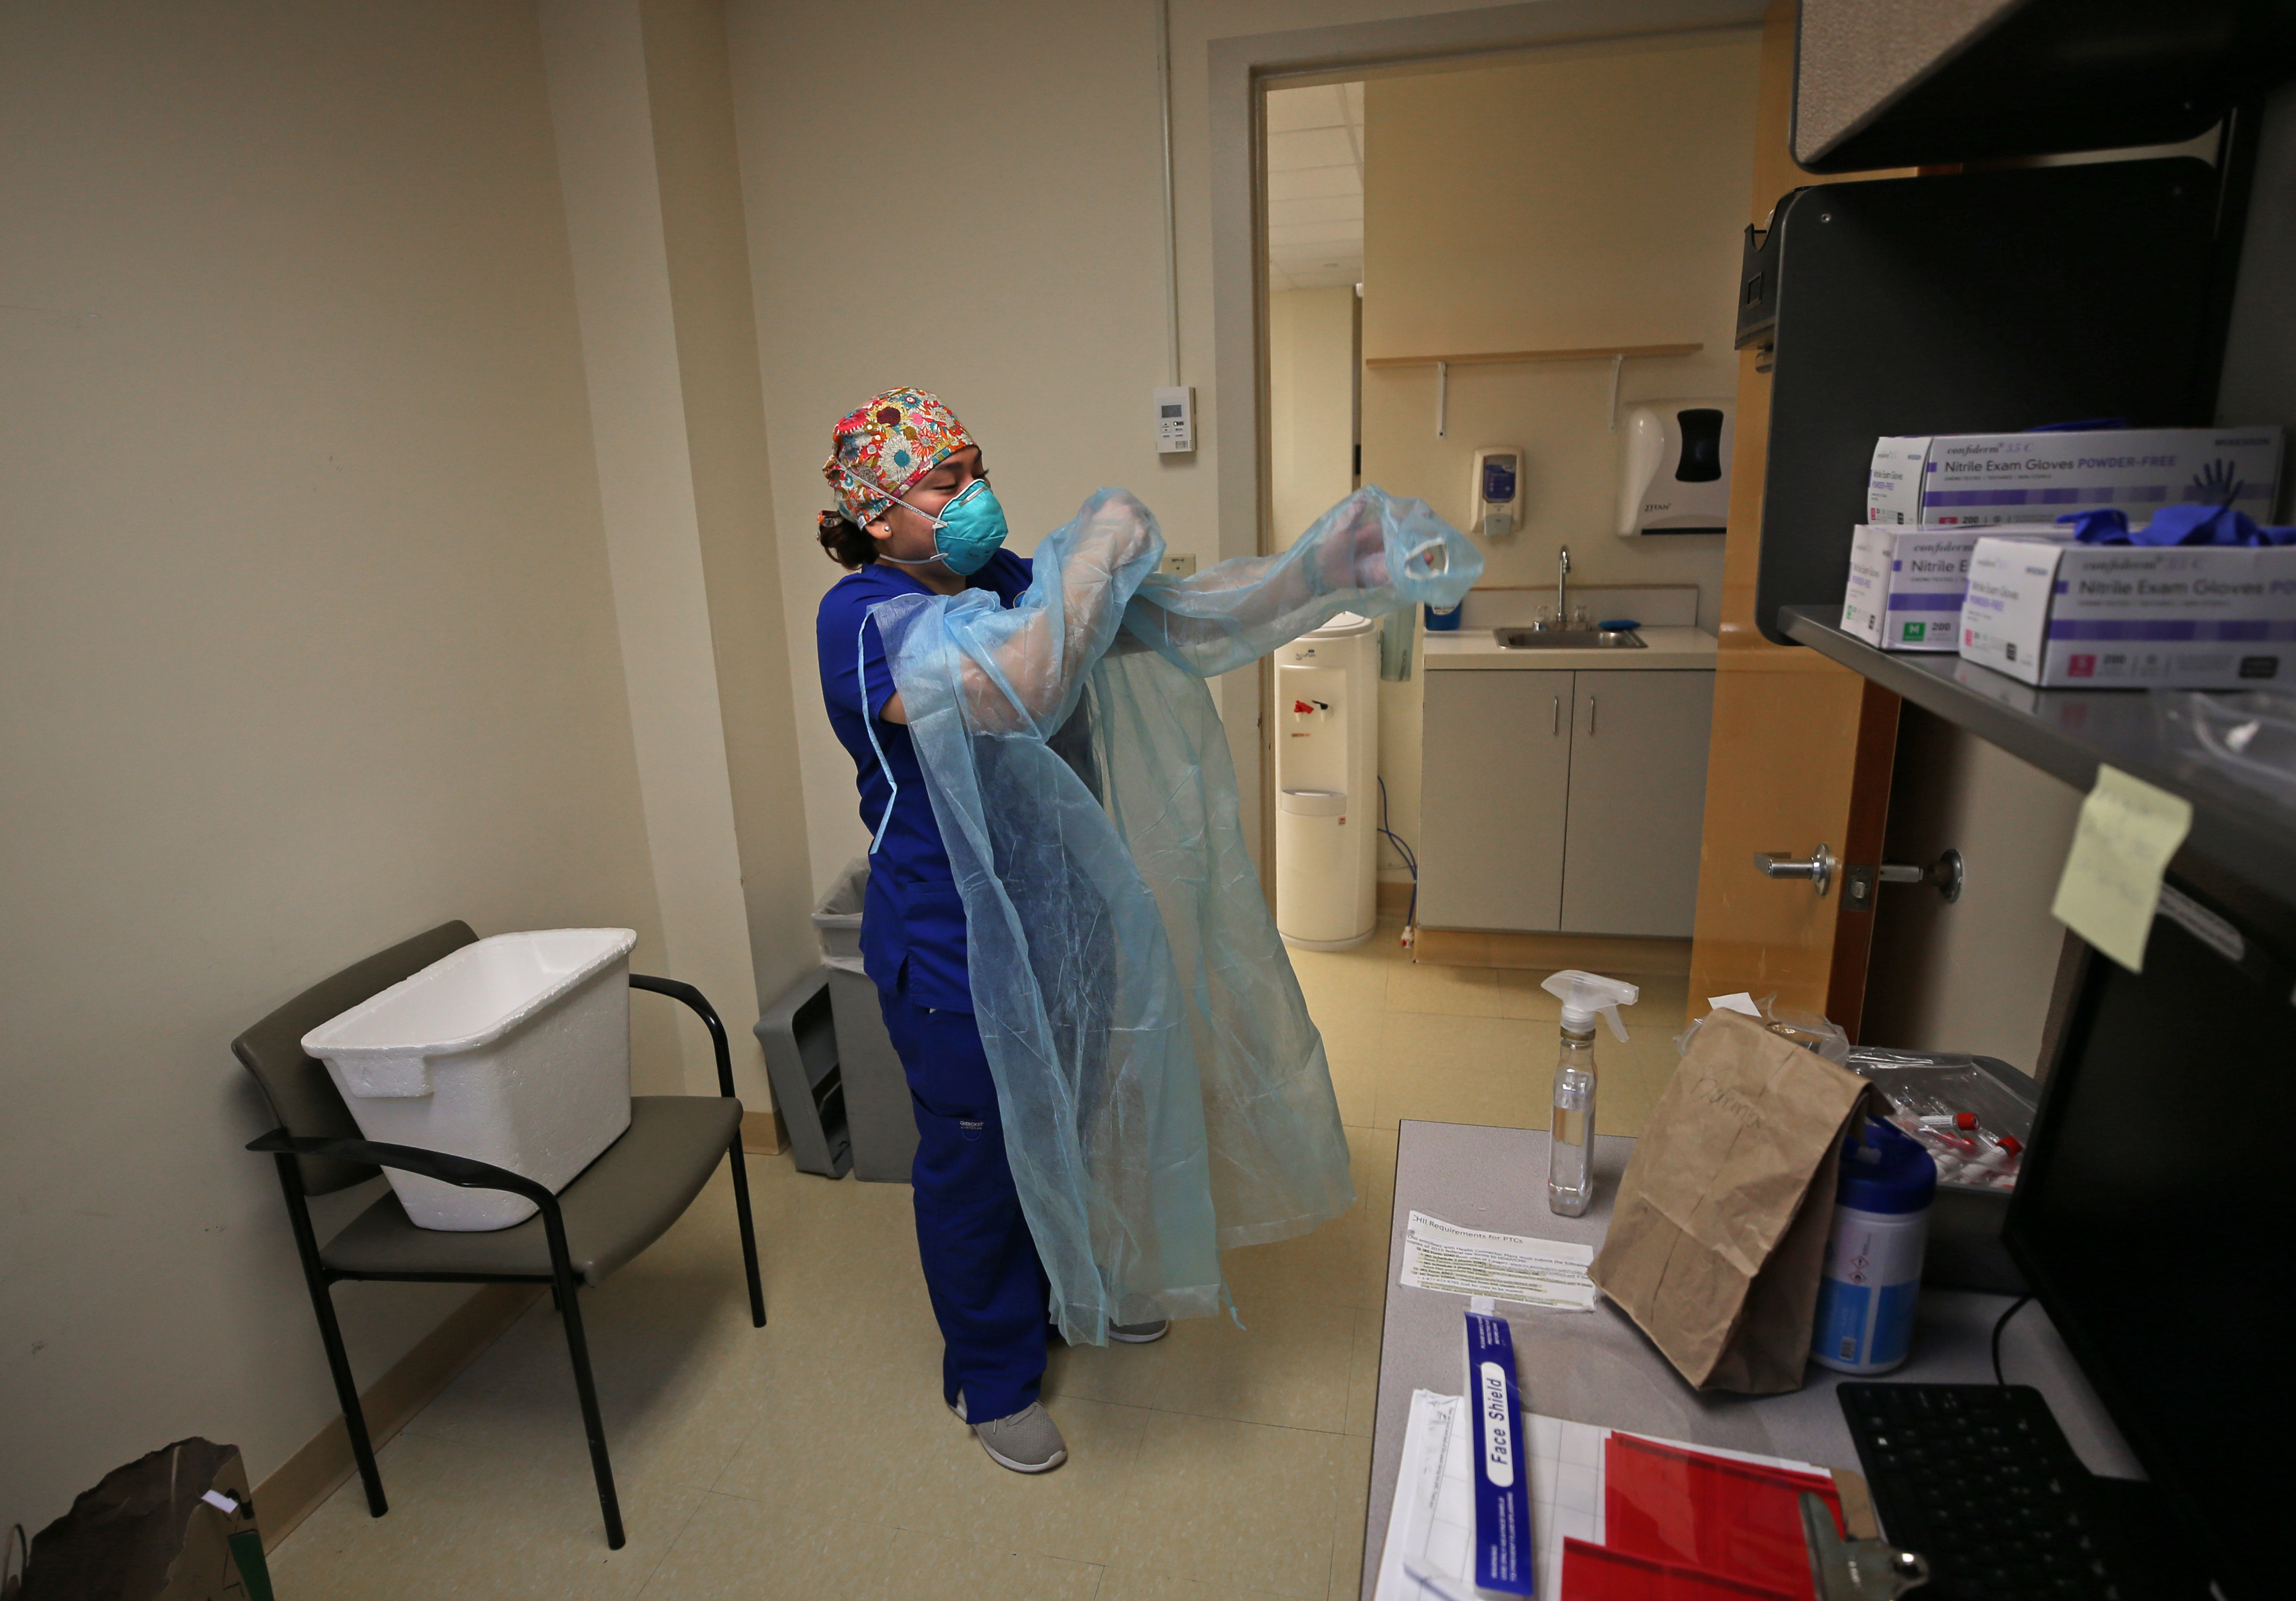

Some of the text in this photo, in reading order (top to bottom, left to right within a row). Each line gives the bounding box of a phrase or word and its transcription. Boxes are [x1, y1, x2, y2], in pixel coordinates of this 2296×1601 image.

[1945, 456, 2176, 473] Nitrile Exam Gloves POWDER-FREE
[1962, 515, 1979, 523] 200
[1911, 560, 1955, 572] Nitrile
[2079, 579, 2133, 595] Nitrile
[2137, 579, 2188, 595] Exam
[2193, 578, 2265, 595] Gloves
[1932, 623, 1951, 631] 200
[1429, 1220, 1486, 1239] Requirements
[1486, 1377, 1508, 1465] Face Shield
